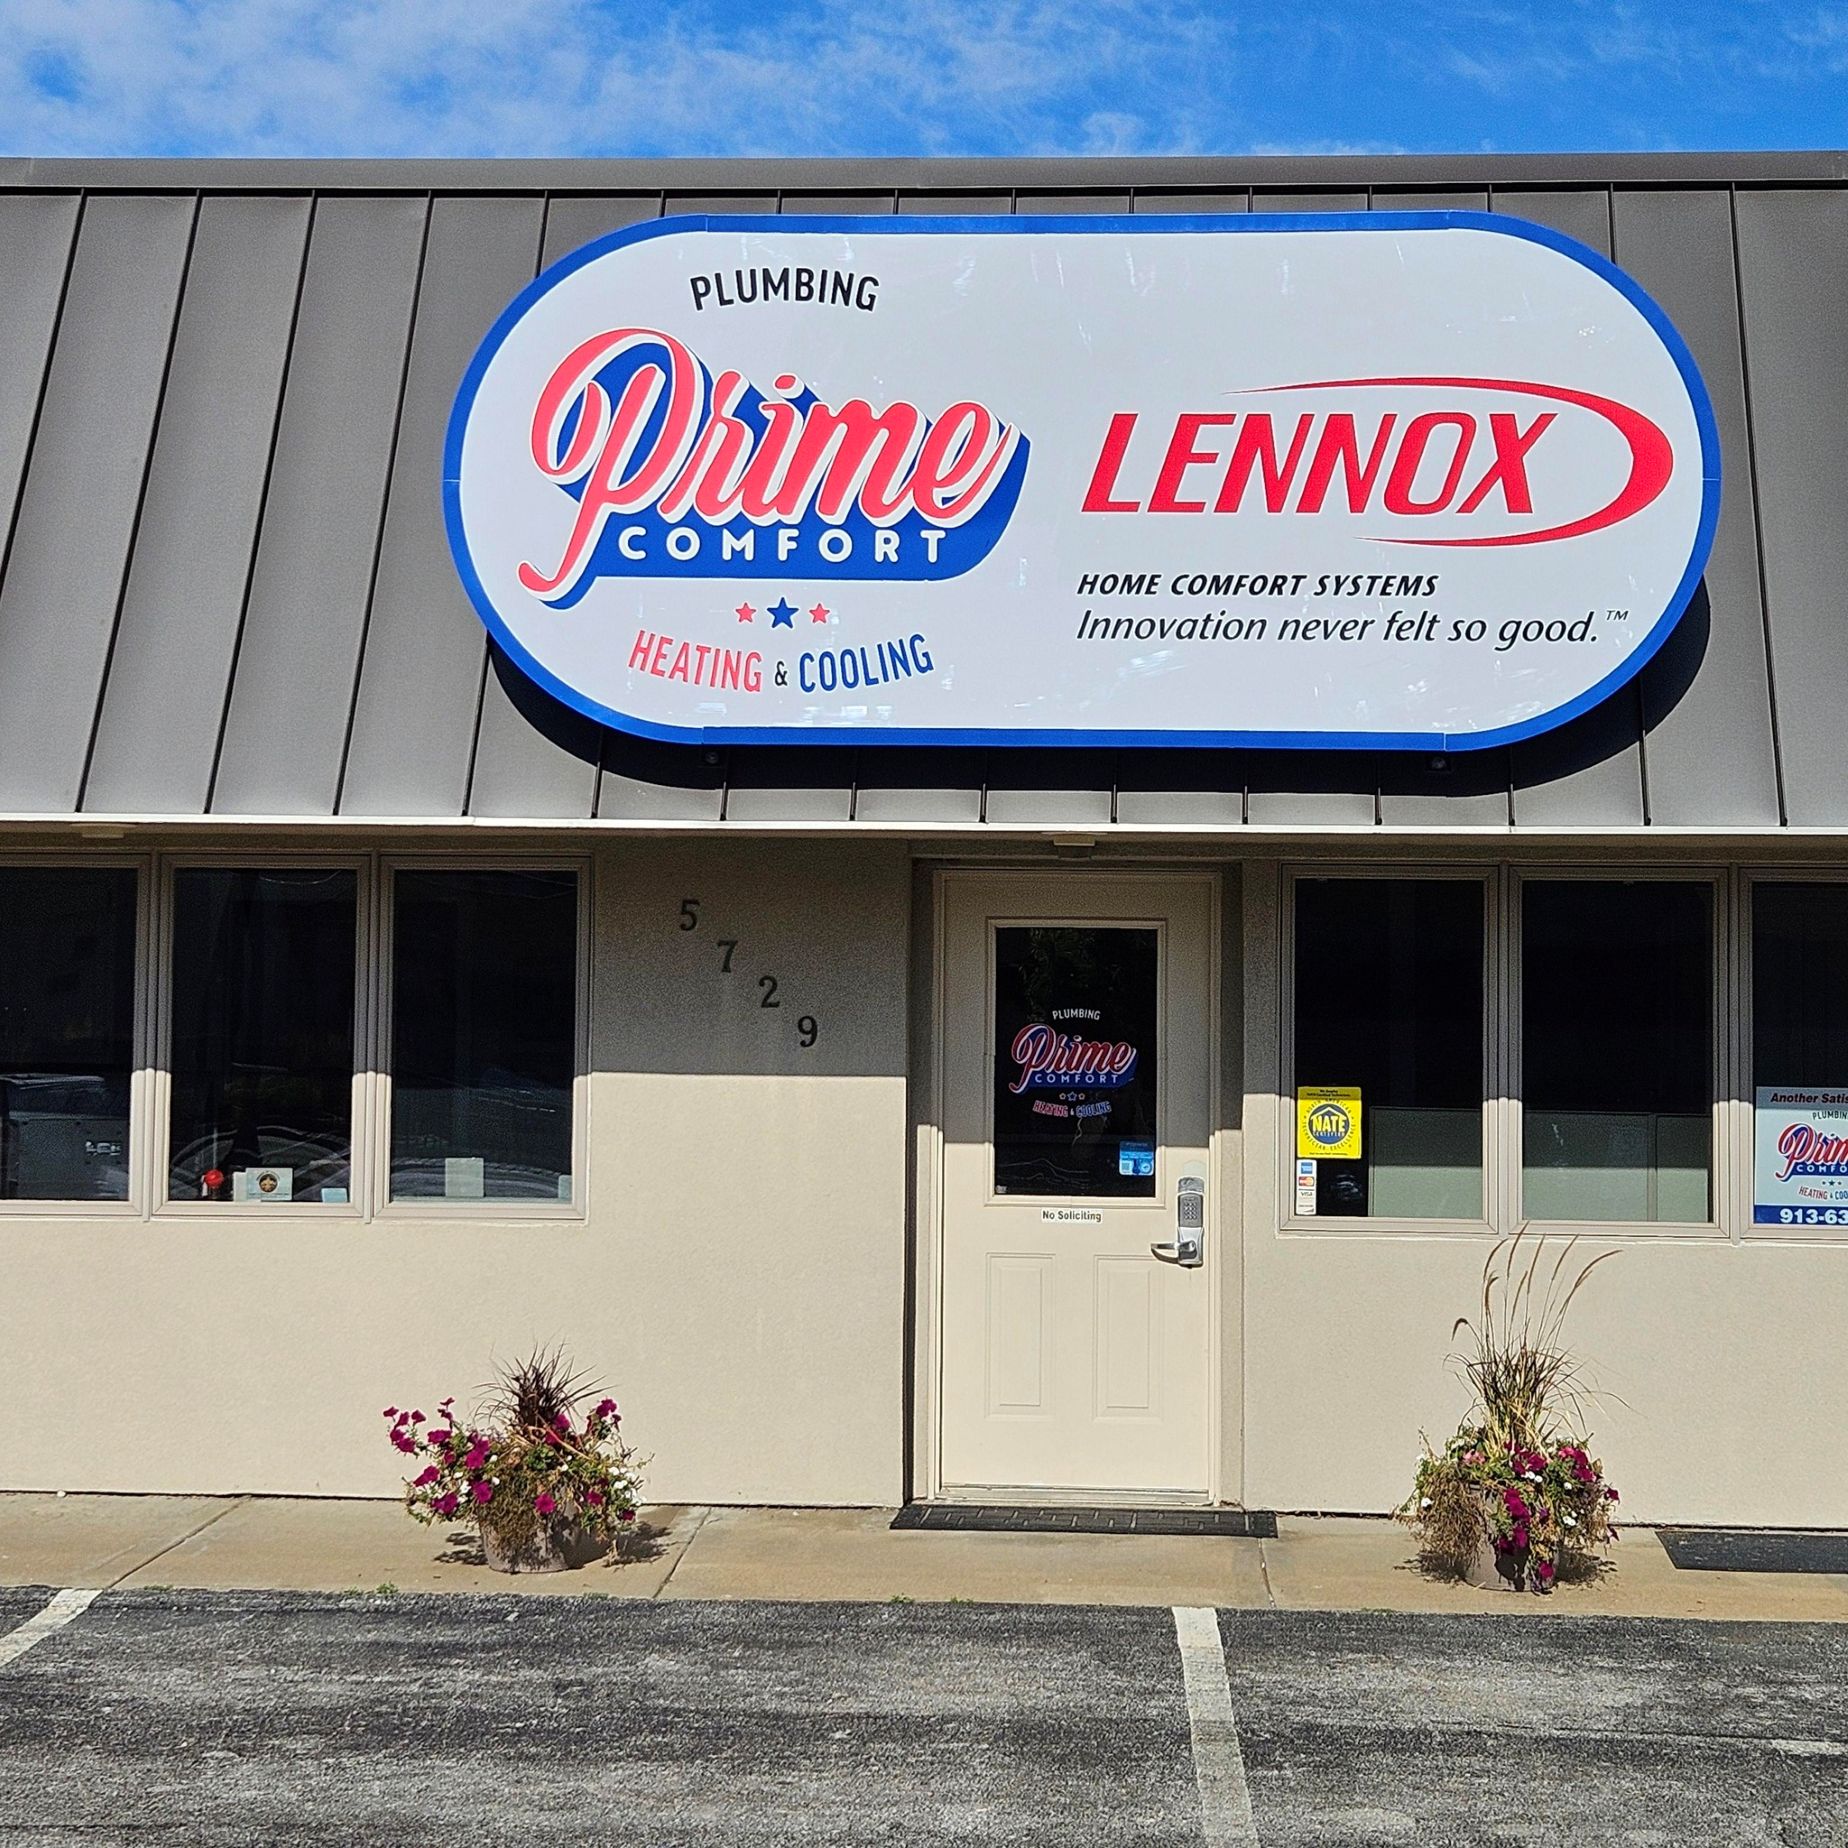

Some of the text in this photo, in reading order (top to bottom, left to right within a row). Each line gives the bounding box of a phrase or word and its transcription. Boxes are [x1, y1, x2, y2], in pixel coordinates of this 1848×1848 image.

[690, 267, 880, 312] PLUMBING
[518, 327, 1018, 604] Prime
[1081, 412, 1559, 516] LENNOX
[618, 526, 947, 563] COMFORT
[1077, 574, 1439, 598] HOME COMFORT SYSTEMS
[1077, 610, 1267, 642] Innovation
[1277, 616, 1374, 642] never
[1381, 611, 1437, 643] felt
[1448, 617, 1485, 643] so
[627, 630, 934, 692] HEATING & COOLING
[1052, 1008, 1101, 1021] PLUMBING
[1008, 1023, 1137, 1093] Prime
[1034, 1073, 1118, 1084] COMFORT
[1032, 1100, 1069, 1118] HEATING
[1076, 1100, 1113, 1118] COOLING
[1770, 1093, 1819, 1104] Another
[1312, 1115, 1346, 1132] NATE
[1798, 1186, 1828, 1200] HEATING
[1042, 1210, 1102, 1222] No Soliciting
[1780, 1208, 1848, 1225] 913-63
